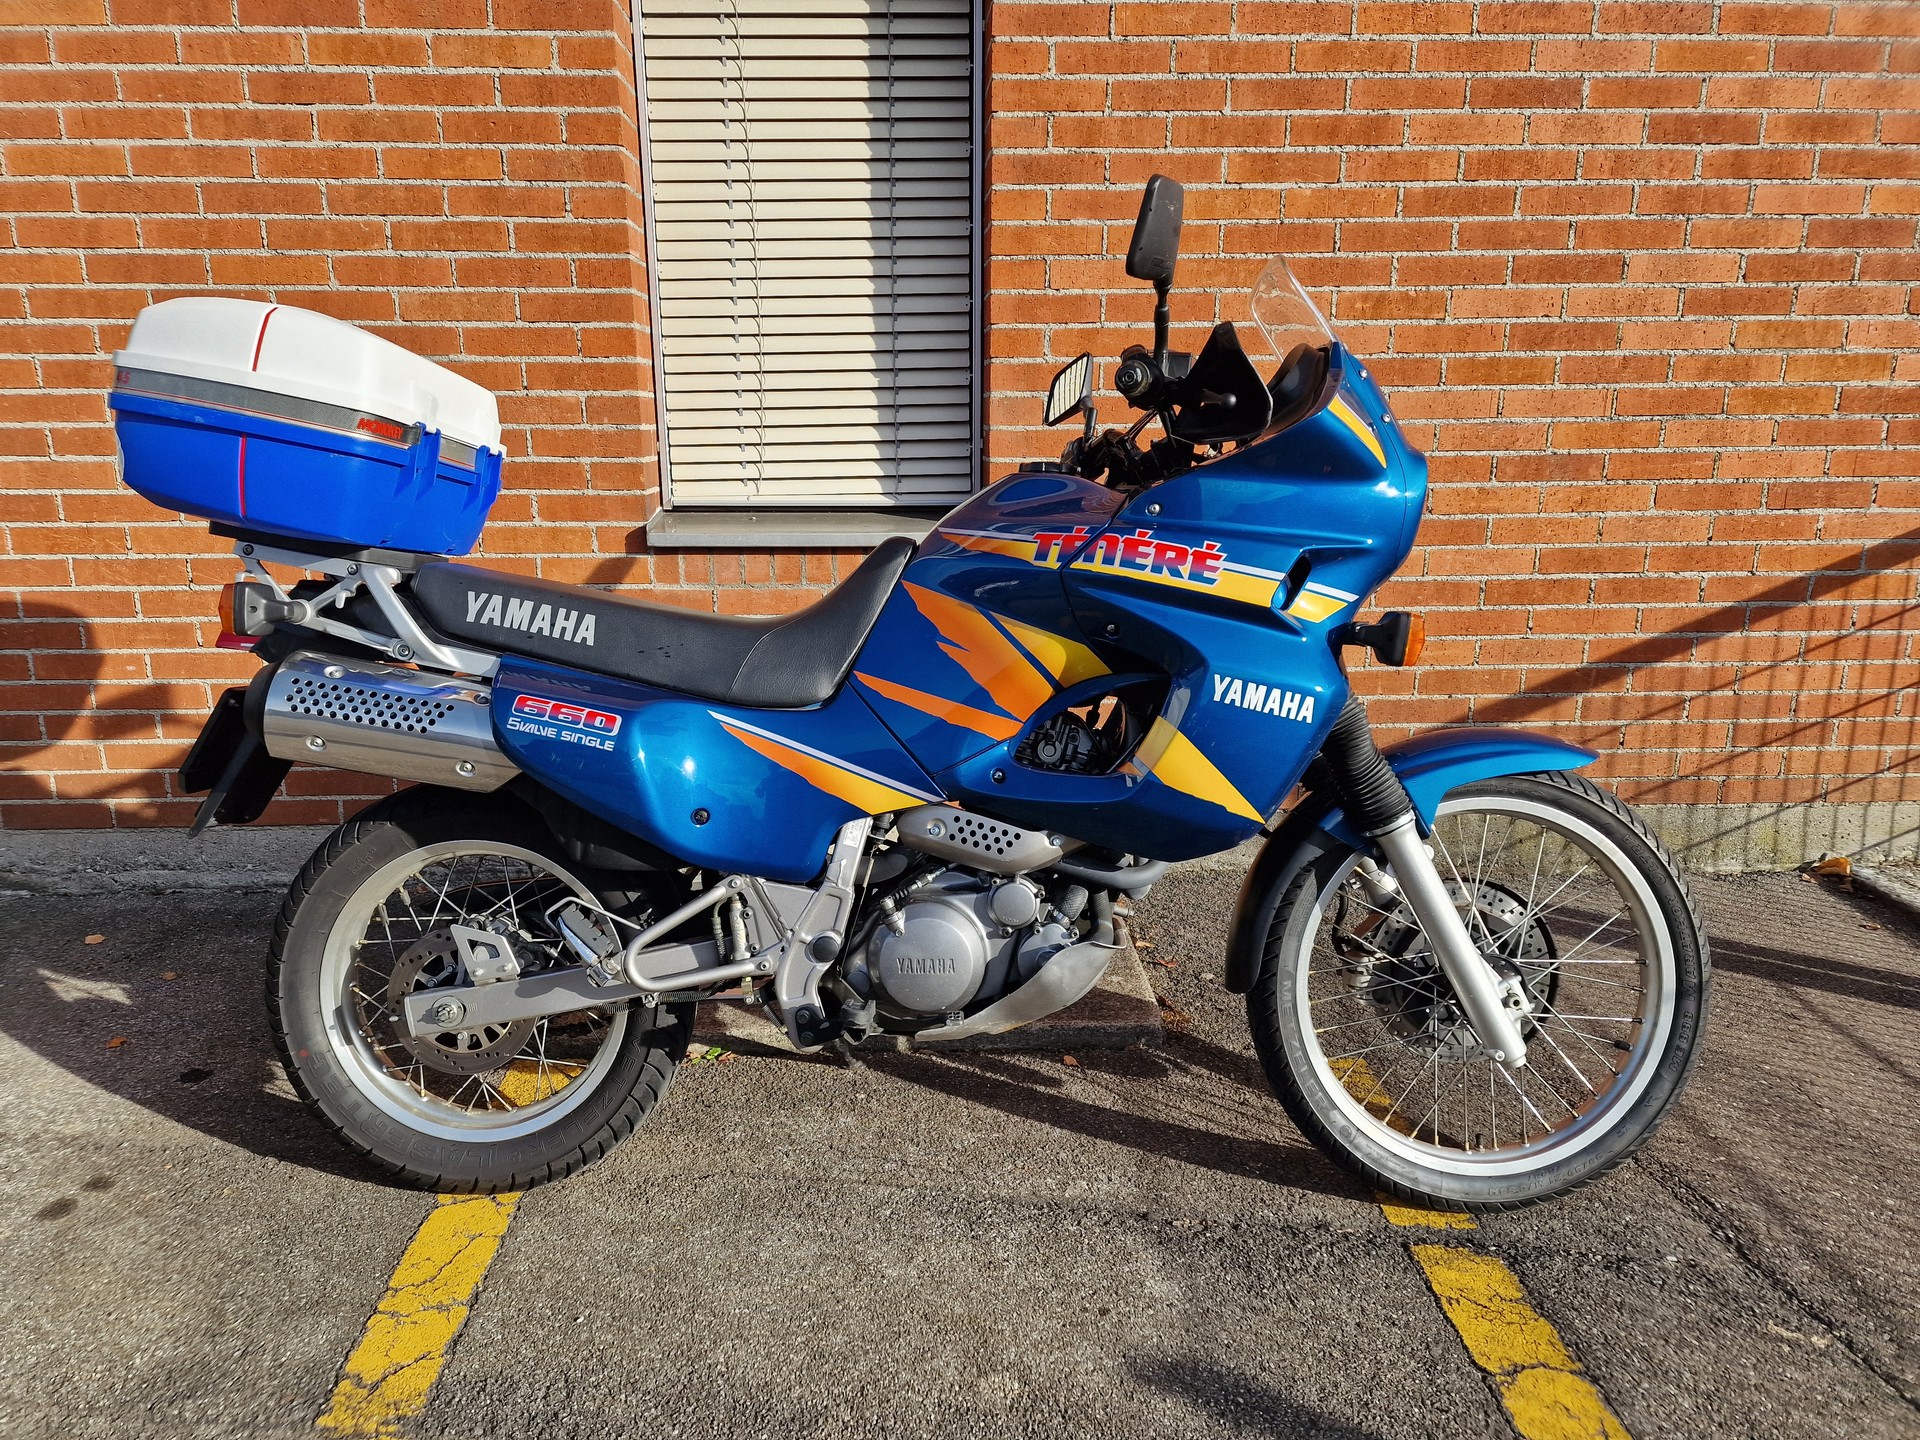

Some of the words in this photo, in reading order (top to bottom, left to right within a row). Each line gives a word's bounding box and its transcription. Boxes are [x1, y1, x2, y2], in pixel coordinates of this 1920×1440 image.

[1032, 525, 1227, 586] TÉNÉRÉ
[466, 591, 596, 646] YAMAHA
[512, 694, 622, 737] 660
[1213, 673, 1315, 724] YAMAHA
[560, 731, 615, 752] SINGLE
[896, 957, 956, 975] YAMAHA
[1280, 979, 1331, 1111] METZELER
[306, 1052, 498, 1168] LASERTEC
[529, 1033, 643, 1157] METZELER
